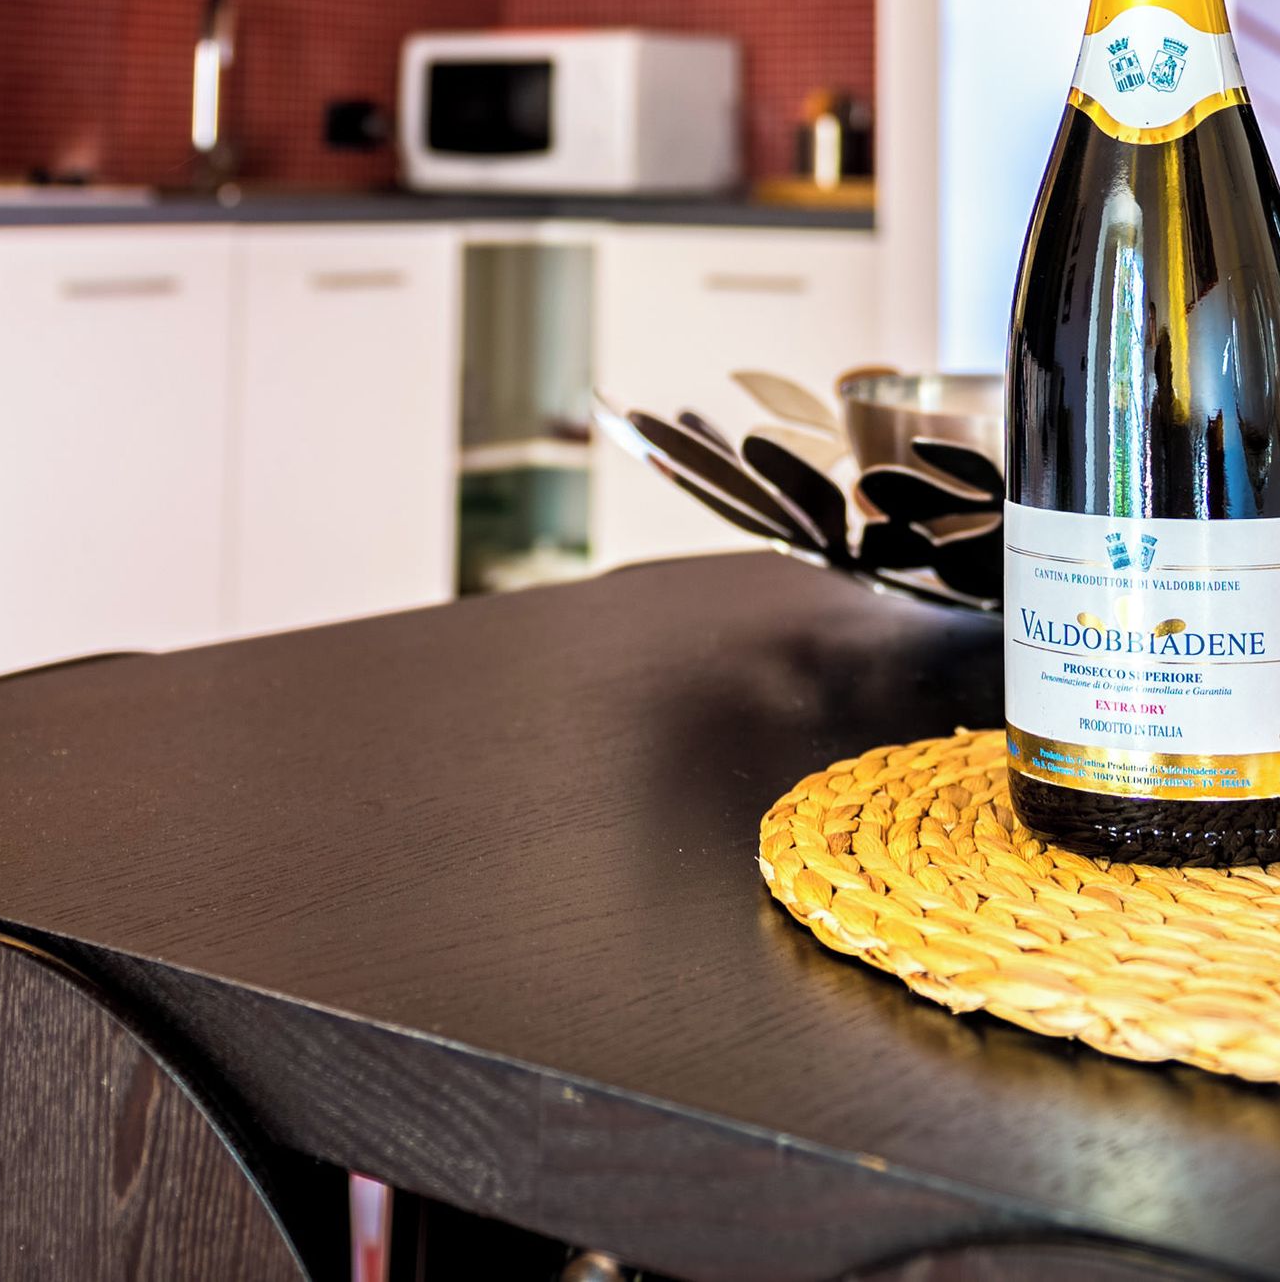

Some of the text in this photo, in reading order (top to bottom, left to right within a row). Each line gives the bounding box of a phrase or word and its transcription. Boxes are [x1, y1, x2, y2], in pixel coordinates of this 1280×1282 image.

[1034, 567, 1069, 583] CANTINA
[1071, 573, 1133, 589] PRODUTTORI
[1152, 578, 1241, 591] VALDOBBIADENE
[1020, 607, 1266, 656] VALDOBBIADENE
[1063, 662, 1126, 680] PROSECCO
[1040, 671, 1092, 688] Denominazione
[1093, 680, 1101, 689] di
[1193, 686, 1233, 696] Garantita
[1095, 699, 1167, 715] EXTRA DRY
[1079, 717, 1183, 738] PRODOTTO IN ITALIA
